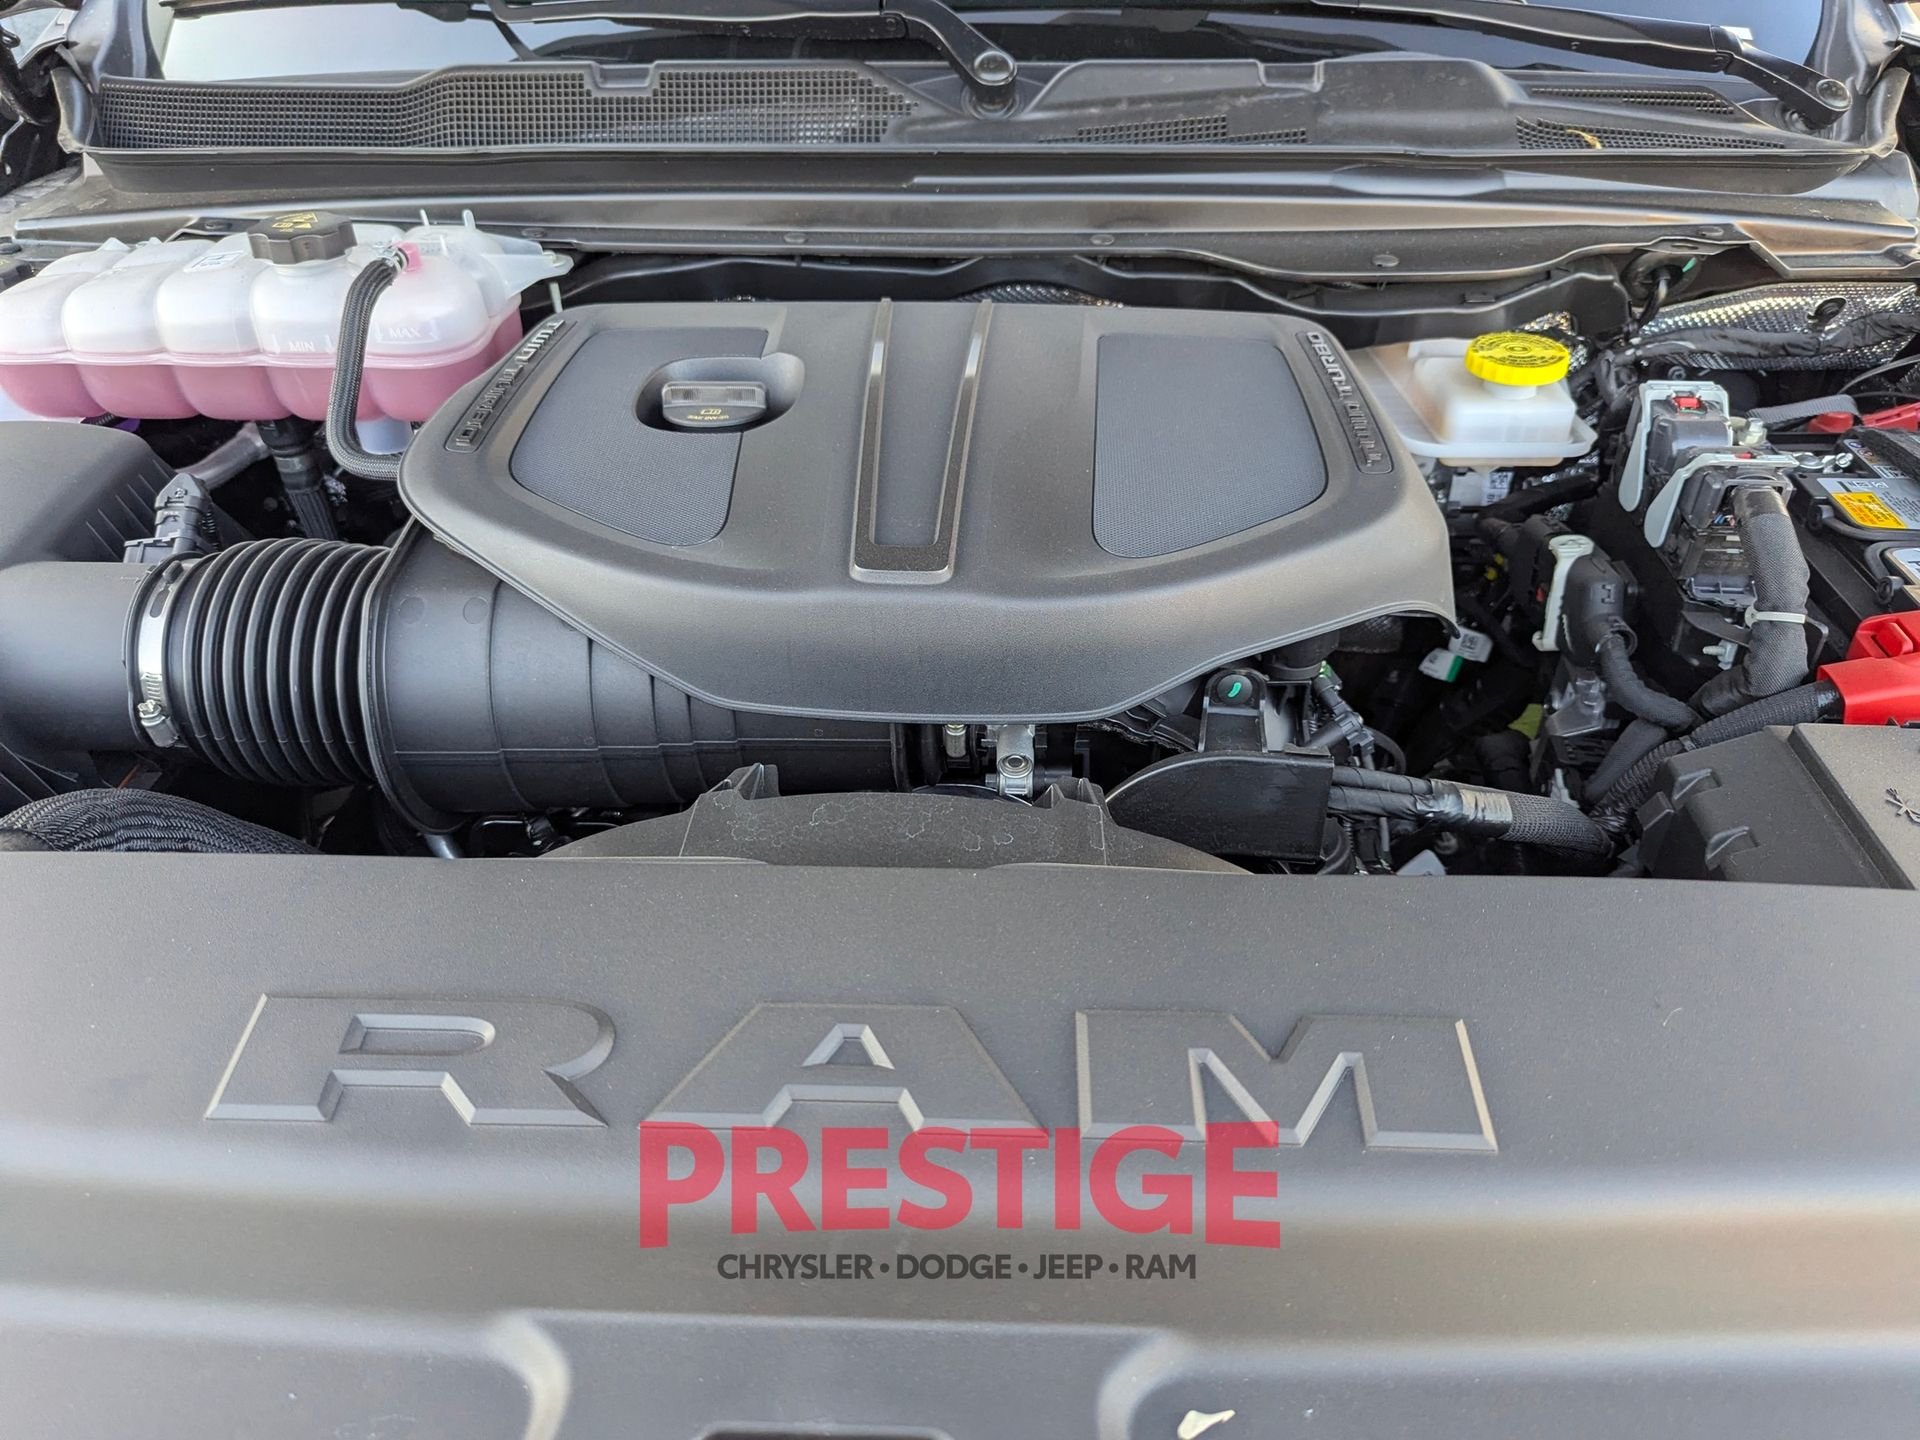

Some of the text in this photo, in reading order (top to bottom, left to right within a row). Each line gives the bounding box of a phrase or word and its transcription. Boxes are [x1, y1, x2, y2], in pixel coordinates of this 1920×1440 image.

[388, 326, 421, 339] MAX
[288, 340, 316, 352] MIN
[205, 992, 1499, 1154] RAM
